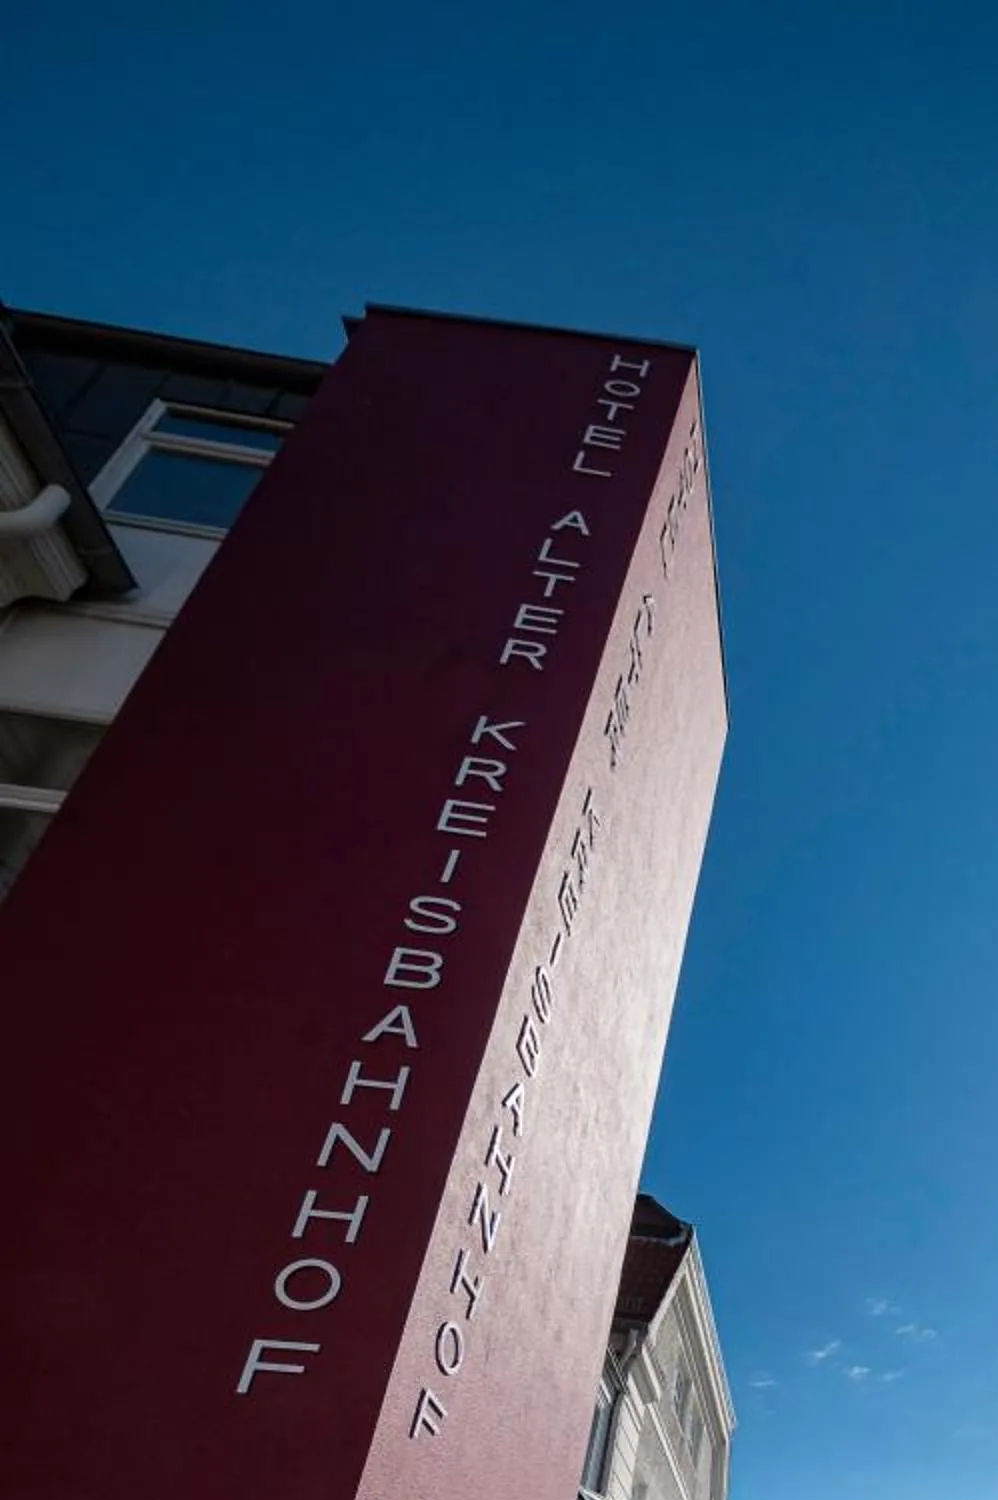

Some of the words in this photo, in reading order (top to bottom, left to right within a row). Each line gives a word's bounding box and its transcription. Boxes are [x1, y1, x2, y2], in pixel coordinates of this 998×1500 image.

[572, 353, 650, 478] HOTEL
[499, 509, 591, 671] ALTER
[603, 594, 655, 772] ALTER
[235, 714, 526, 1395] KREISBAHNHOF
[409, 786, 601, 1440] KREISBAHNHOF
